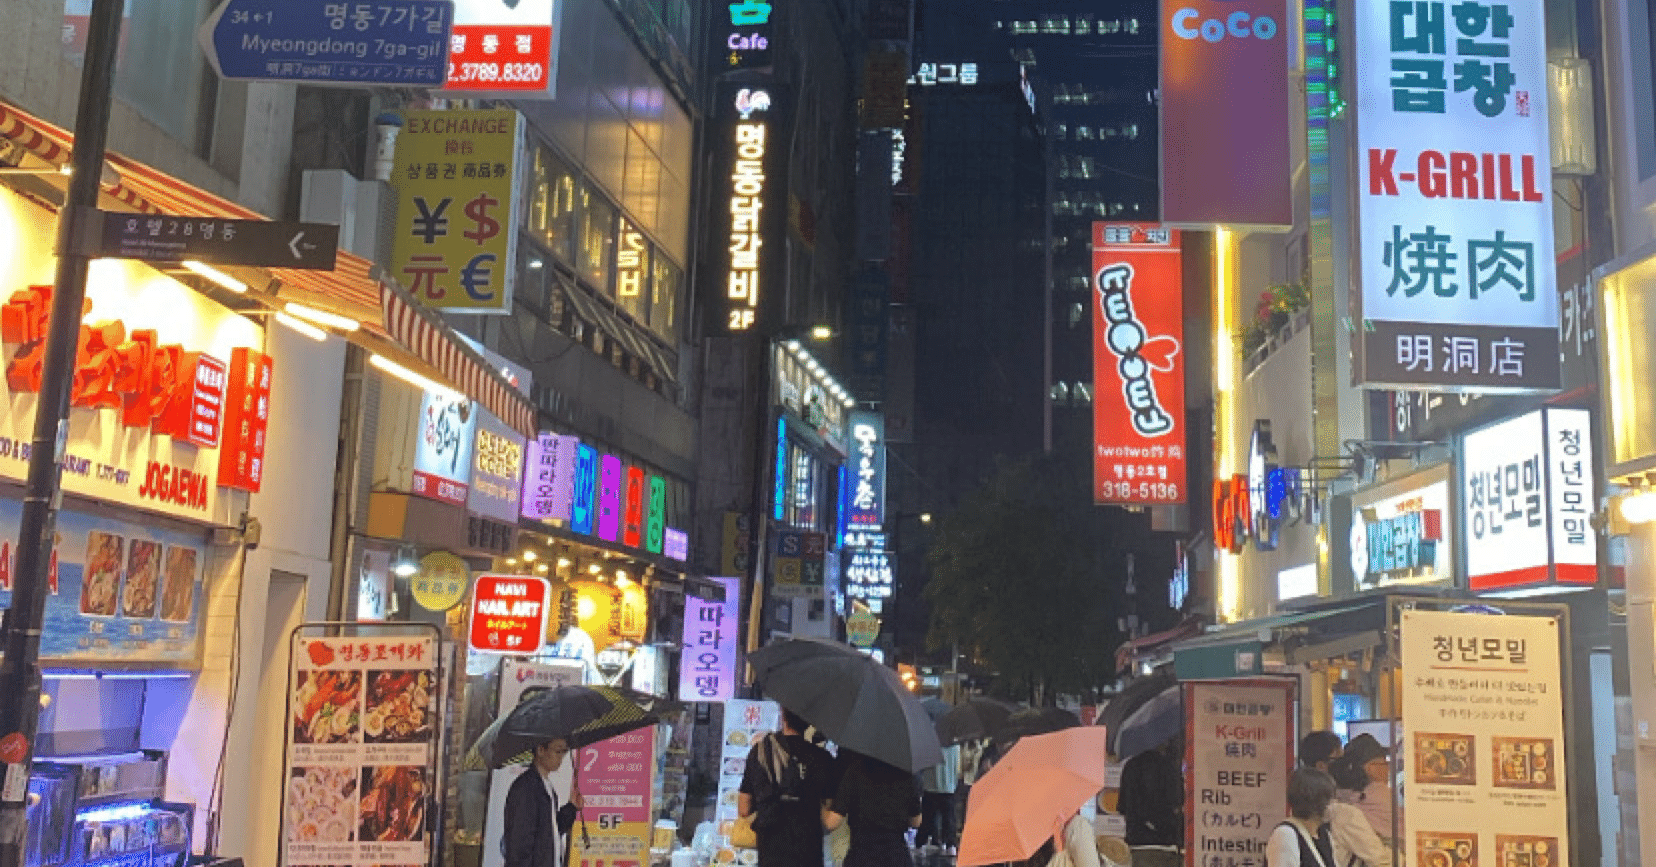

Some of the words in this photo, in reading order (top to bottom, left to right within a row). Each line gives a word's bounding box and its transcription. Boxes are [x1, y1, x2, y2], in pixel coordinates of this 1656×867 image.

[324, 3, 442, 34] 명동7가길
[1172, 8, 1277, 42] CoCo
[1390, 1, 1515, 57] 대한
[241, 34, 368, 59] Myeongdong
[374, 38, 442, 61] 7ga-gil
[727, 33, 768, 50] Cafe
[905, 62, 978, 86] 원그룹
[1390, 59, 1517, 117] 곱창
[407, 117, 509, 135] EXCHANGE
[1368, 149, 1543, 202] K-GRILL
[463, 193, 501, 247] $
[727, 122, 767, 308] 명동닭갈비
[1383, 224, 1536, 301] 焼肉
[402, 254, 450, 301] 元
[459, 253, 498, 302] €
[728, 309, 756, 331] 2F
[1396, 334, 1524, 377] 明洞店
[138, 460, 209, 512] JOGAEWA
[1103, 481, 1177, 500] 318-5136
[1469, 453, 1543, 540] 청년모밀
[1559, 429, 1587, 545] 청년모밀
[494, 582, 527, 597] NAVI
[477, 599, 509, 616] NAIL
[511, 600, 541, 618] ART
[1433, 635, 1526, 663] 청년모밀
[1215, 724, 1267, 741] K-Grill
[583, 747, 600, 773] 2
[1217, 770, 1267, 788] BEEF
[1201, 788, 1231, 806] Rib
